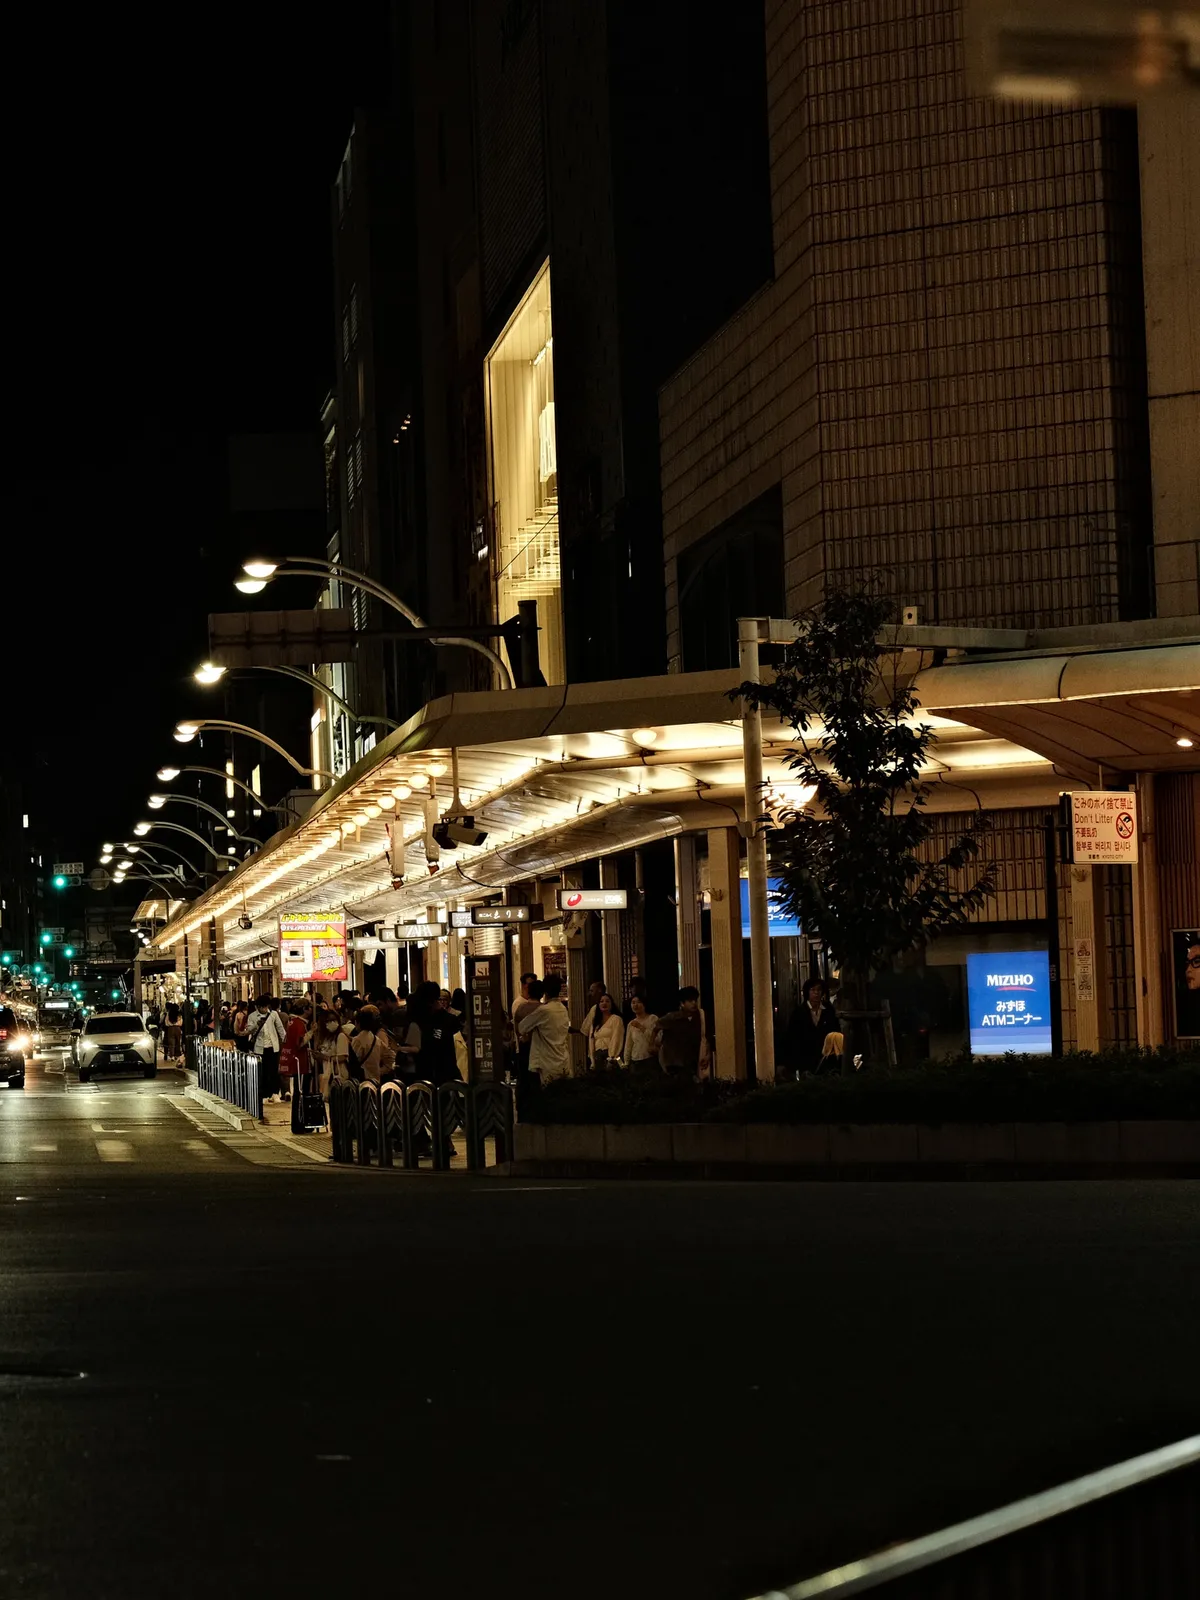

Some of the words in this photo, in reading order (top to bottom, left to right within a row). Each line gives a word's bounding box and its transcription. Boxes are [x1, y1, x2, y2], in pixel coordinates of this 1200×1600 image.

[1074, 813, 1093, 824] Don't
[1095, 813, 1113, 824] Litter
[406, 924, 433, 937] ZARA
[987, 974, 1034, 987] MIZUHO
[996, 1000, 1026, 1012] みずほ
[981, 1013, 1042, 1026] ATMコーナー
